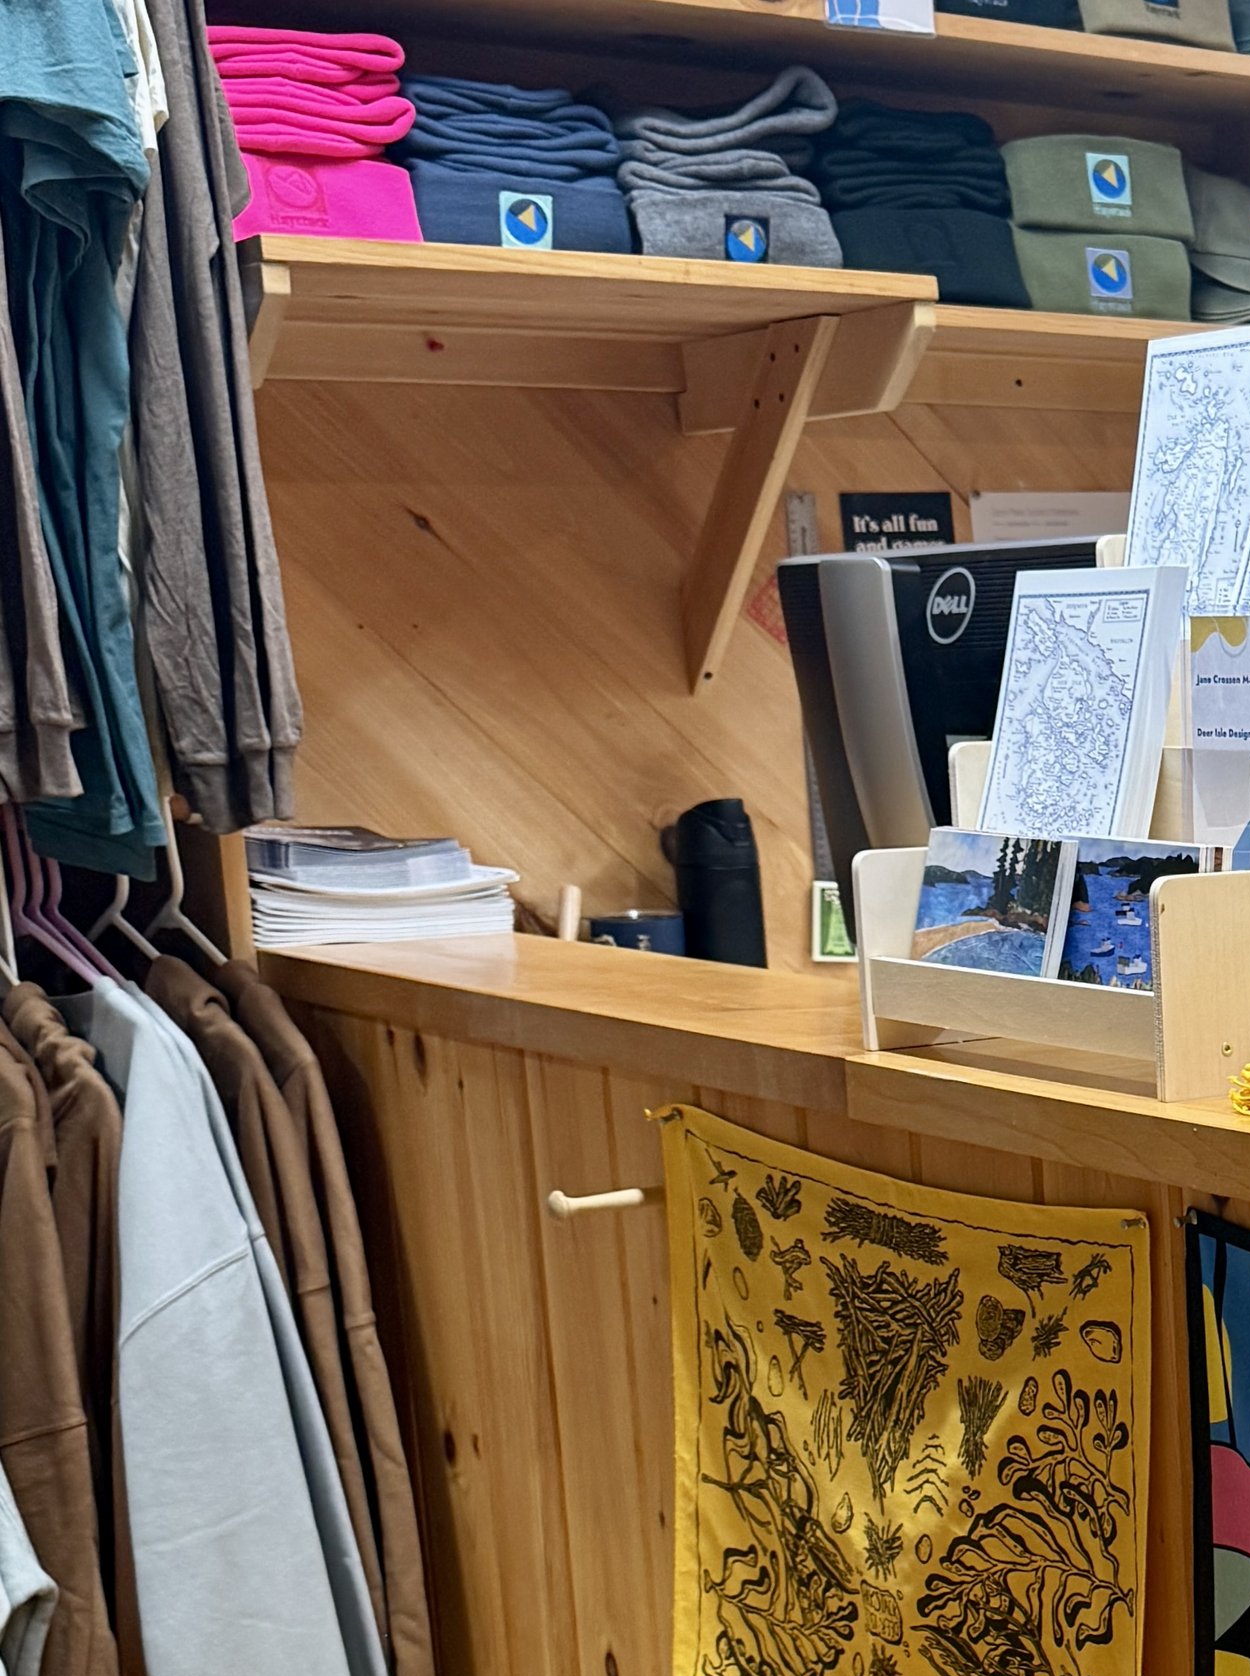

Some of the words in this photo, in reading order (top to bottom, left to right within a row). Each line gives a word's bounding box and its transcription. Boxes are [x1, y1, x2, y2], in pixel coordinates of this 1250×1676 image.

[853, 514, 880, 533] It's
[881, 514, 906, 533] all
[907, 512, 939, 532] fun
[932, 594, 968, 615] DELL
[1196, 674, 1212, 686] Jane
[1197, 728, 1214, 738] Deer
[1214, 728, 1227, 738] Isle
